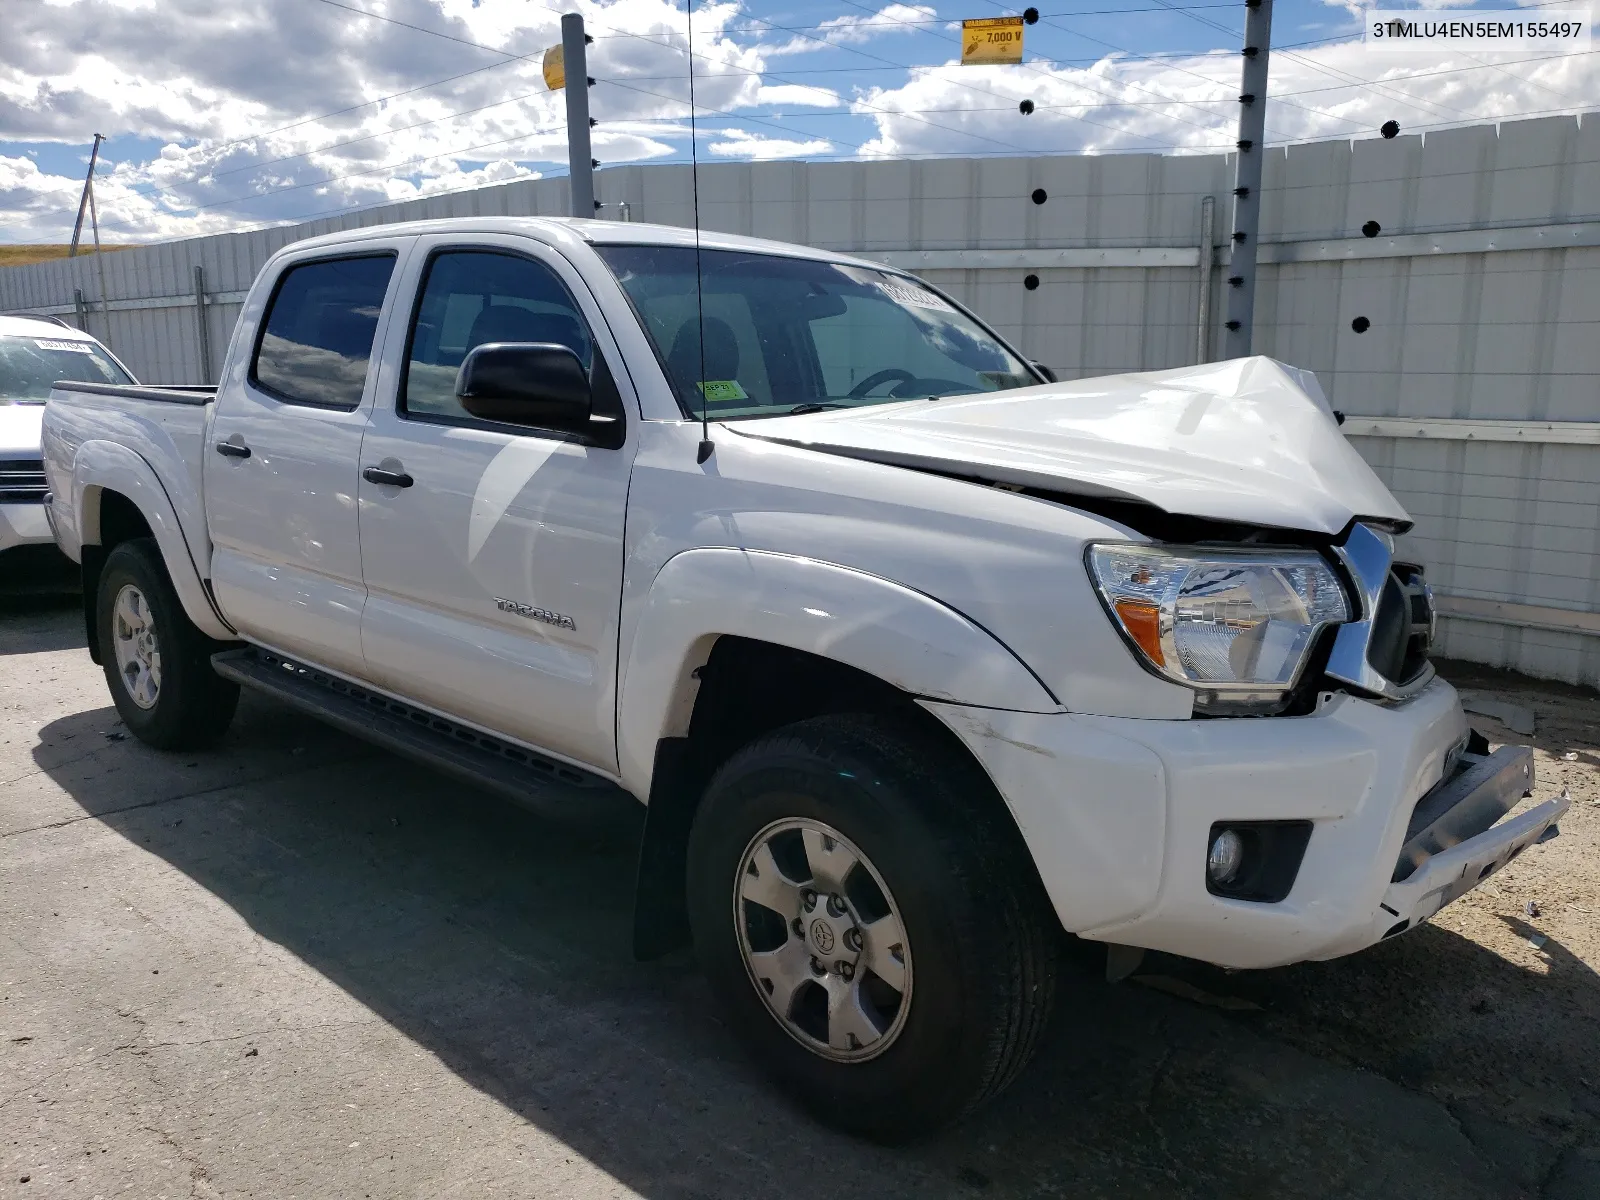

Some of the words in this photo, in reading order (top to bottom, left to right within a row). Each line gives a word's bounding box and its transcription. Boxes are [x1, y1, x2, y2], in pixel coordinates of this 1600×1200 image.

[986, 32, 1012, 44] 7,000
[1015, 31, 1021, 41] V
[493, 596, 577, 632] TACOMA
